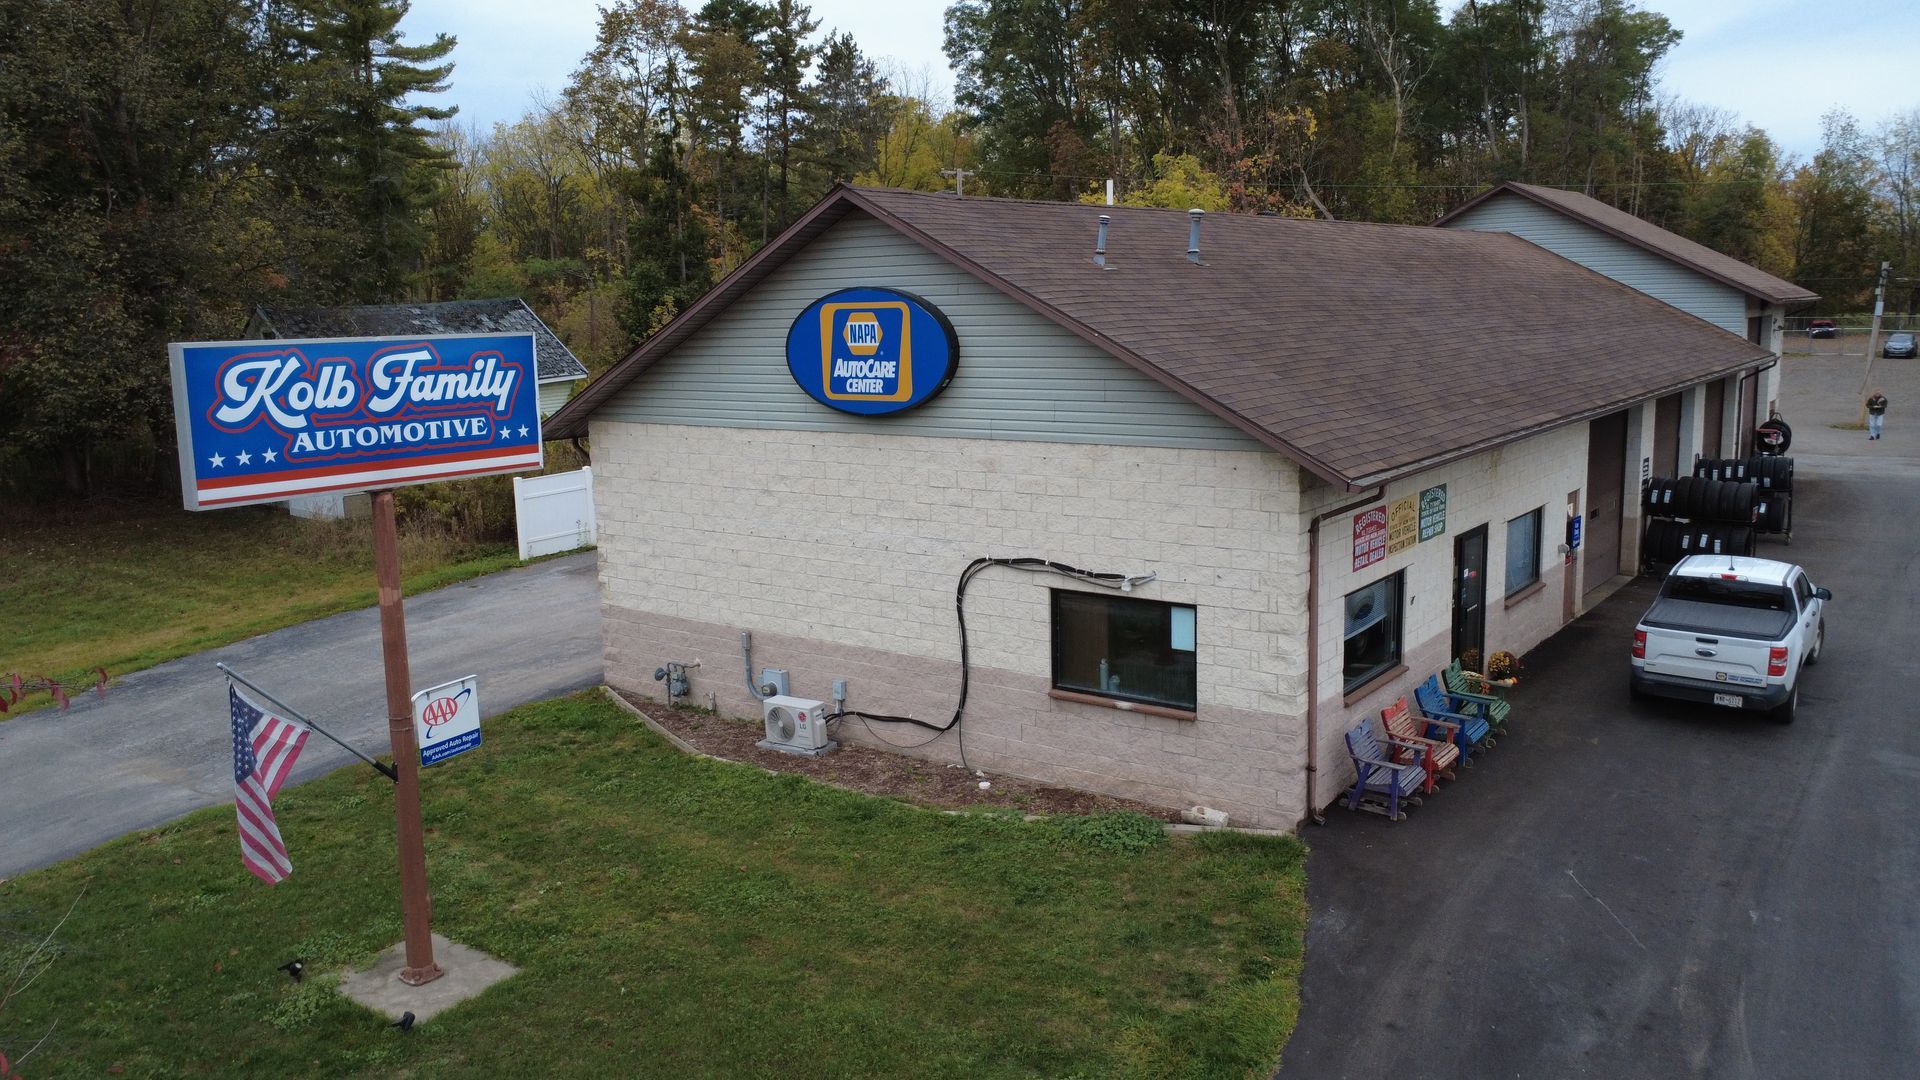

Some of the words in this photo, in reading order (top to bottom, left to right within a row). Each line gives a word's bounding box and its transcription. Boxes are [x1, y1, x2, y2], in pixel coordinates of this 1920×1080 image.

[849, 323, 877, 344] NAPA
[215, 356, 355, 429] Kolb
[367, 350, 517, 413] Family
[846, 378, 884, 393] CENTER
[291, 417, 488, 453] AUTOMOTIVE
[1355, 510, 1385, 535] REGISTERED
[1391, 500, 1415, 521] OFFICIAL
[426, 697, 454, 726] AAA
[422, 741, 449, 758] Approved
[449, 738, 462, 748] Auto
[462, 732, 479, 742] Repair
